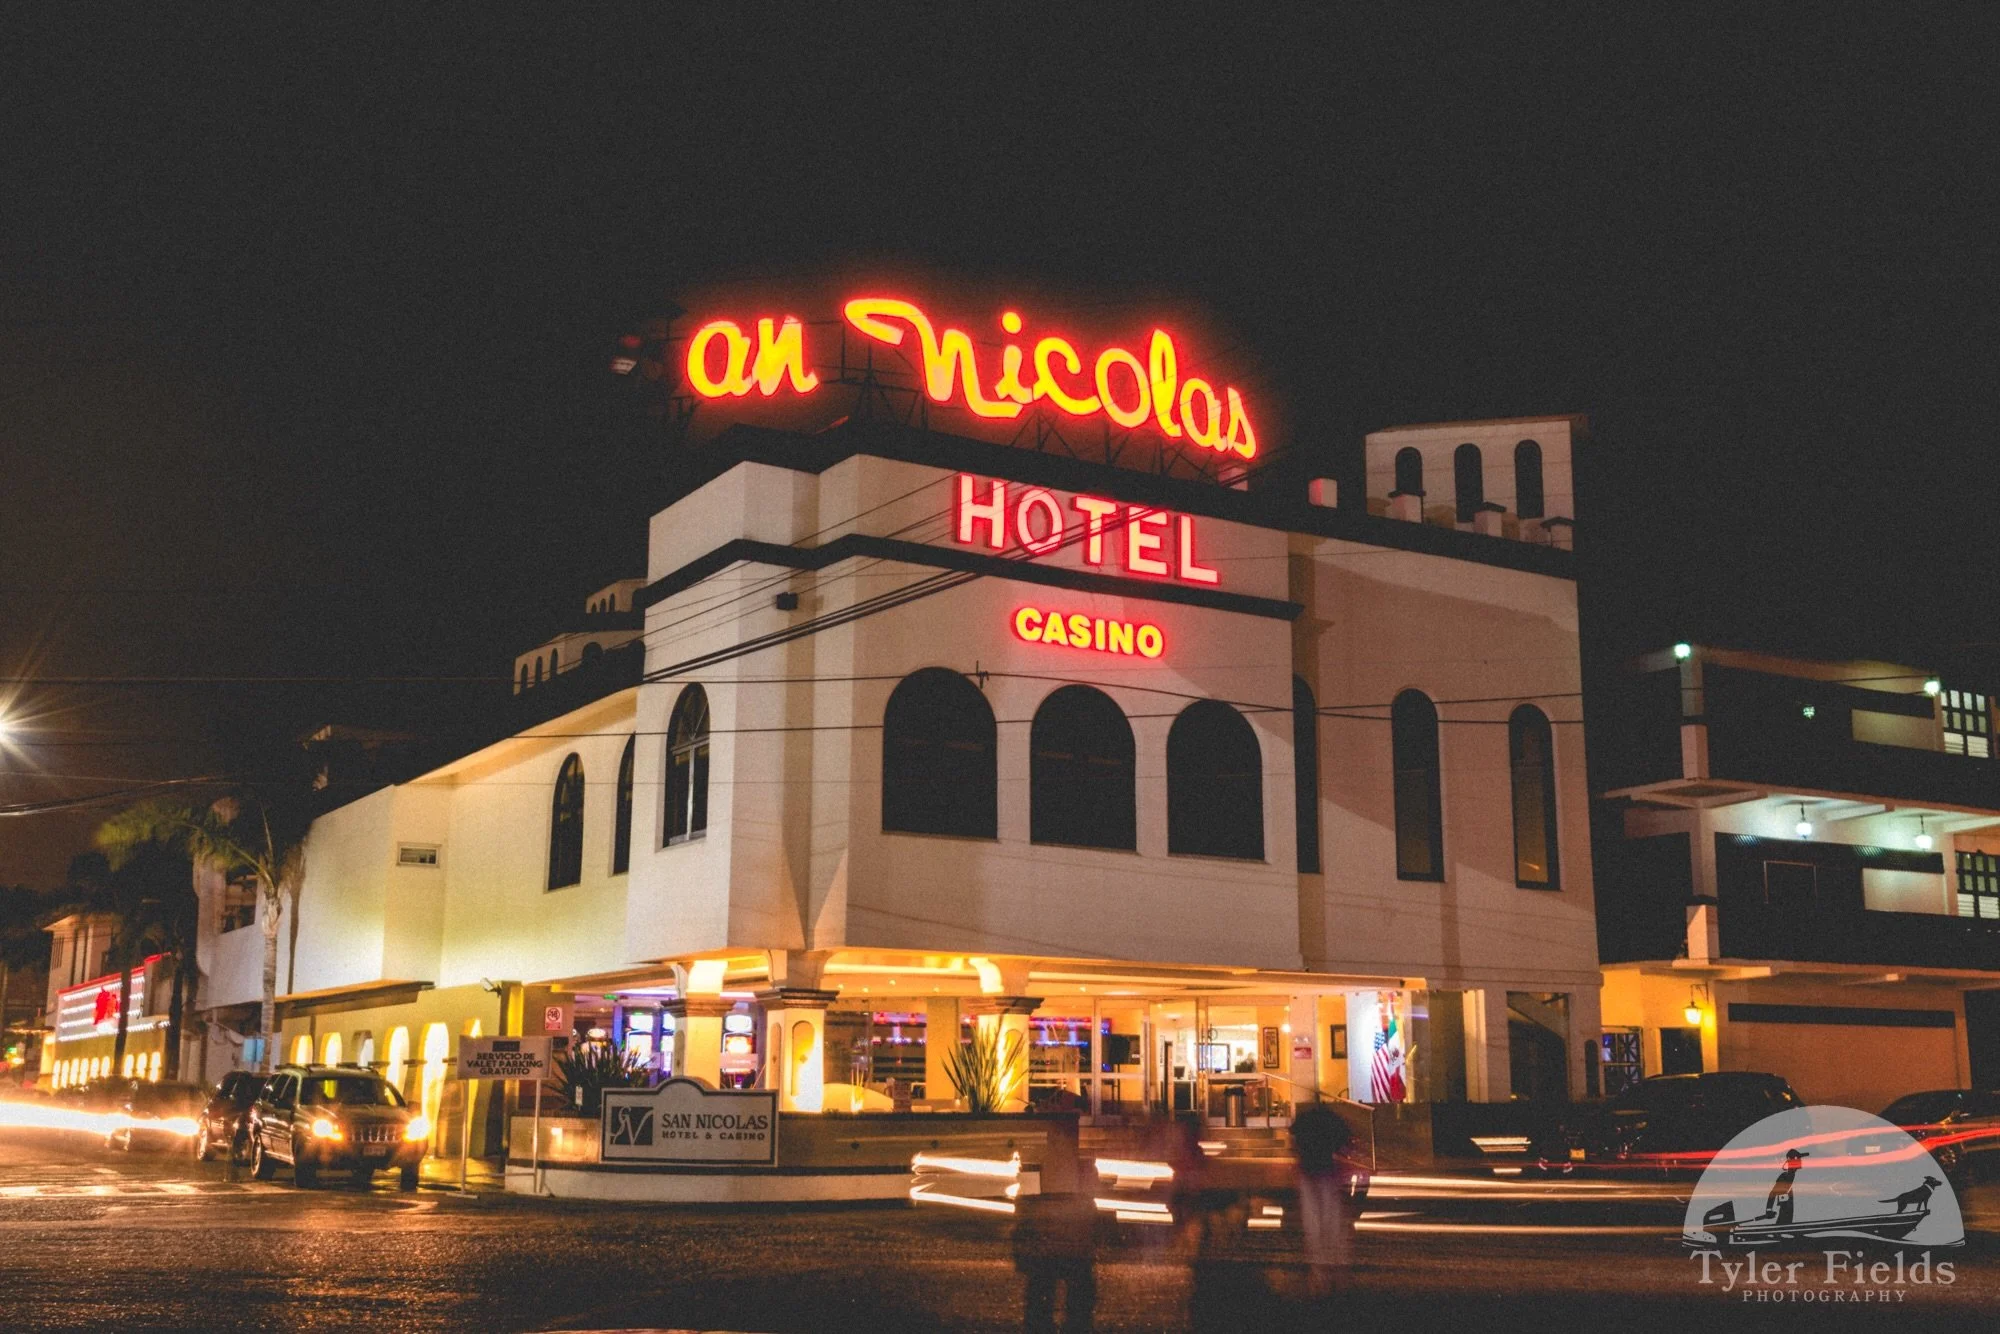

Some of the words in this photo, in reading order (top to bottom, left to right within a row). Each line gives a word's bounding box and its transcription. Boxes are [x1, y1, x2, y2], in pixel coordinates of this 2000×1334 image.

[843, 297, 1257, 459] Nicolas
[957, 473, 1221, 585] HOTEL
[1012, 607, 1164, 658] CASINO
[467, 1060, 497, 1068] VALET
[499, 1060, 543, 1068] PARKING
[661, 1113, 691, 1129] SAN
[696, 1114, 768, 1130] NICOLAS
[662, 1131, 698, 1139] HOTEL
[719, 1132, 765, 1140] CASINO
